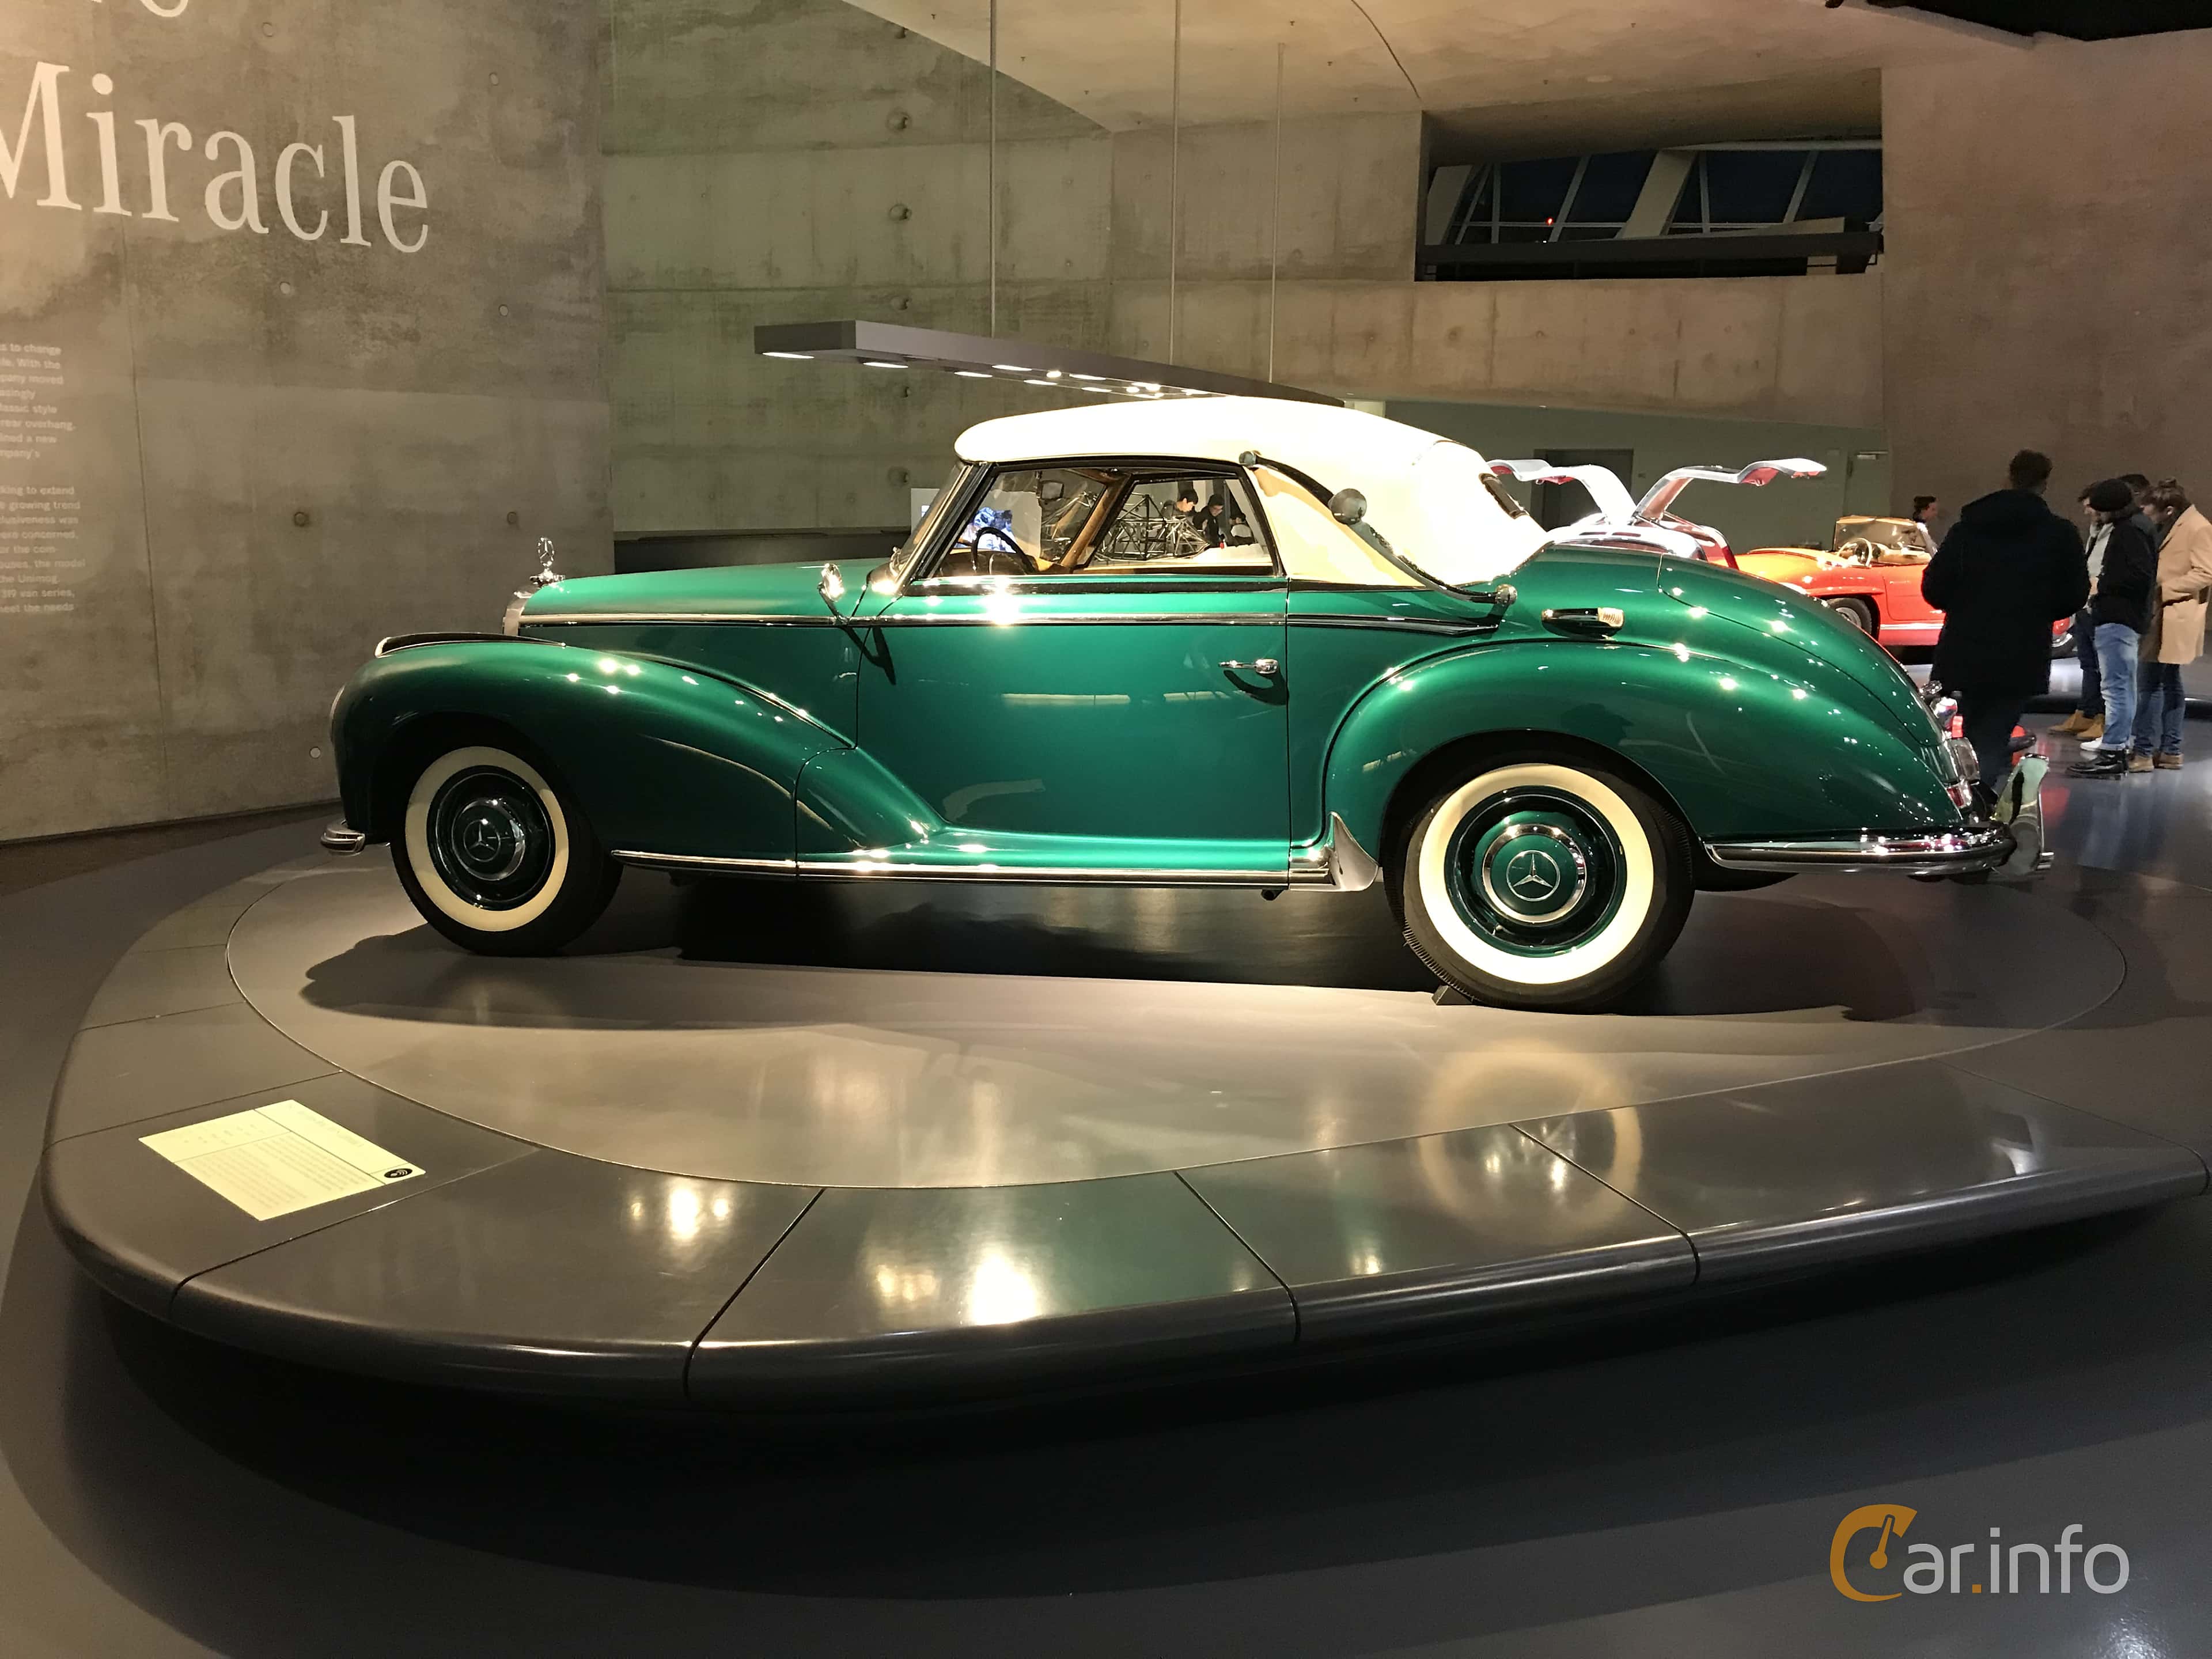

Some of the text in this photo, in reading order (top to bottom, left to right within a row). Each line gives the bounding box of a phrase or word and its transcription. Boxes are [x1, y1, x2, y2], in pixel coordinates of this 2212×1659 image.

[0, 61, 429, 253] Miracle
[10, 344, 21, 352] to
[24, 344, 62, 356] change
[17, 358, 41, 368] With
[43, 360, 60, 369] the
[29, 375, 64, 385] moved
[32, 404, 57, 415] style
[26, 486, 37, 495] to
[40, 486, 75, 495] extend
[9, 501, 51, 512] growing
[53, 500, 81, 510] trend
[59, 516, 79, 524] was
[13, 545, 30, 554] the
[34, 559, 51, 569] the
[54, 558, 86, 568] model
[20, 590, 38, 598] van
[24, 604, 41, 613] the
[43, 602, 75, 612] needs
